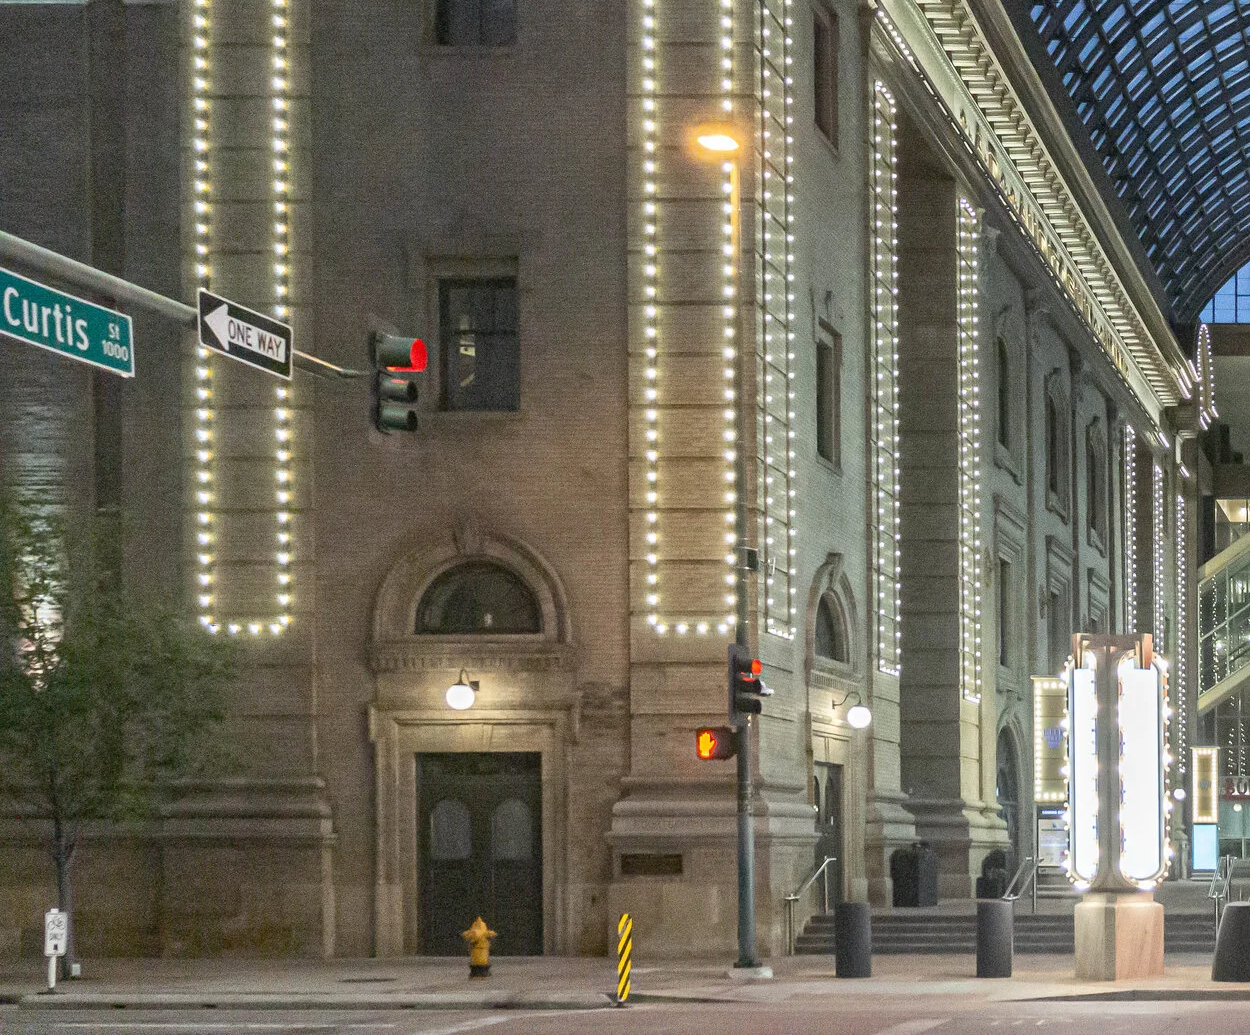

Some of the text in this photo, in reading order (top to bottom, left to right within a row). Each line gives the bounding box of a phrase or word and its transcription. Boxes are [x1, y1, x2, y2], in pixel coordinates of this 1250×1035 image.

[3, 286, 120, 351] Curtis St
[228, 318, 283, 360] ONE WAY
[101, 339, 129, 362] 1000
